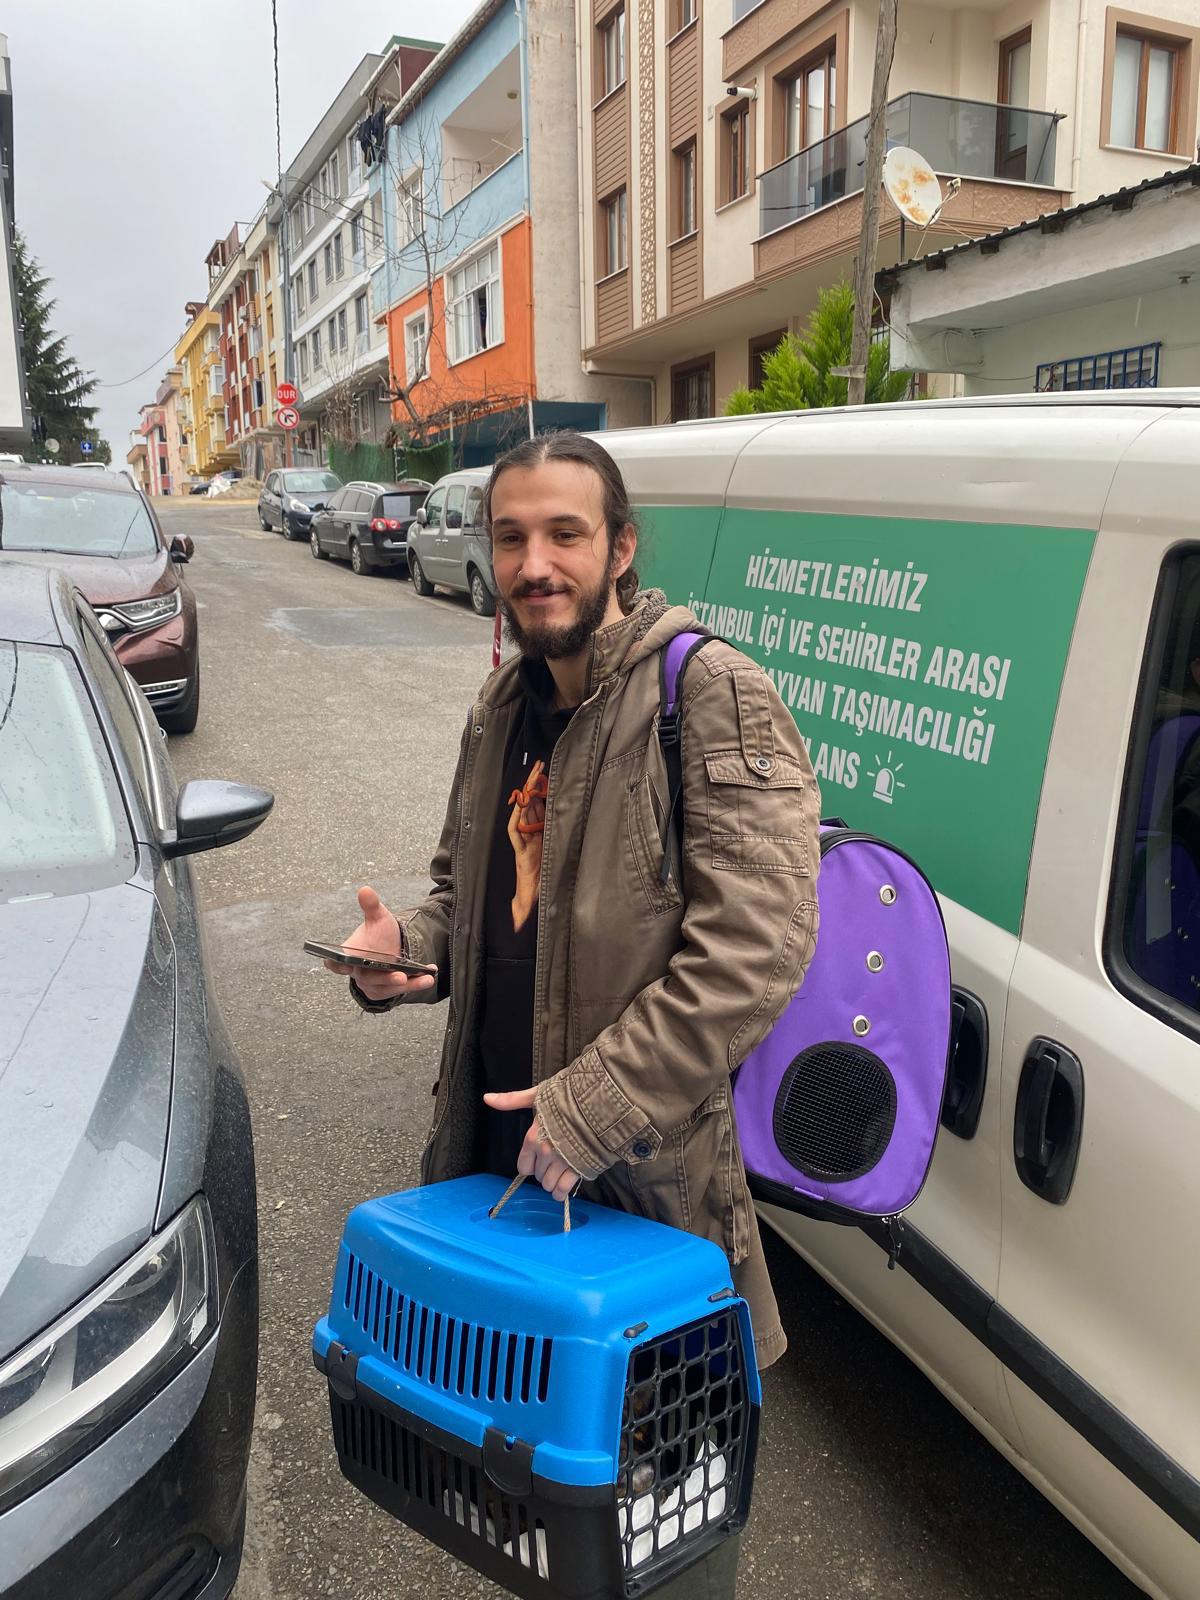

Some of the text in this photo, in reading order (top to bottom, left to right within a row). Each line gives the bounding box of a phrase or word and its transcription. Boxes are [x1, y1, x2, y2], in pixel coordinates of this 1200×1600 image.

[277, 389, 296, 399] DUR
[745, 547, 928, 612] HİZMETLERİMİZ
[758, 605, 787, 656] İÇİ
[789, 618, 814, 657] VE
[815, 621, 922, 681] SEHİRLER
[923, 645, 1012, 701] ARASI
[831, 684, 996, 765] TAŞIMACILIĞI
